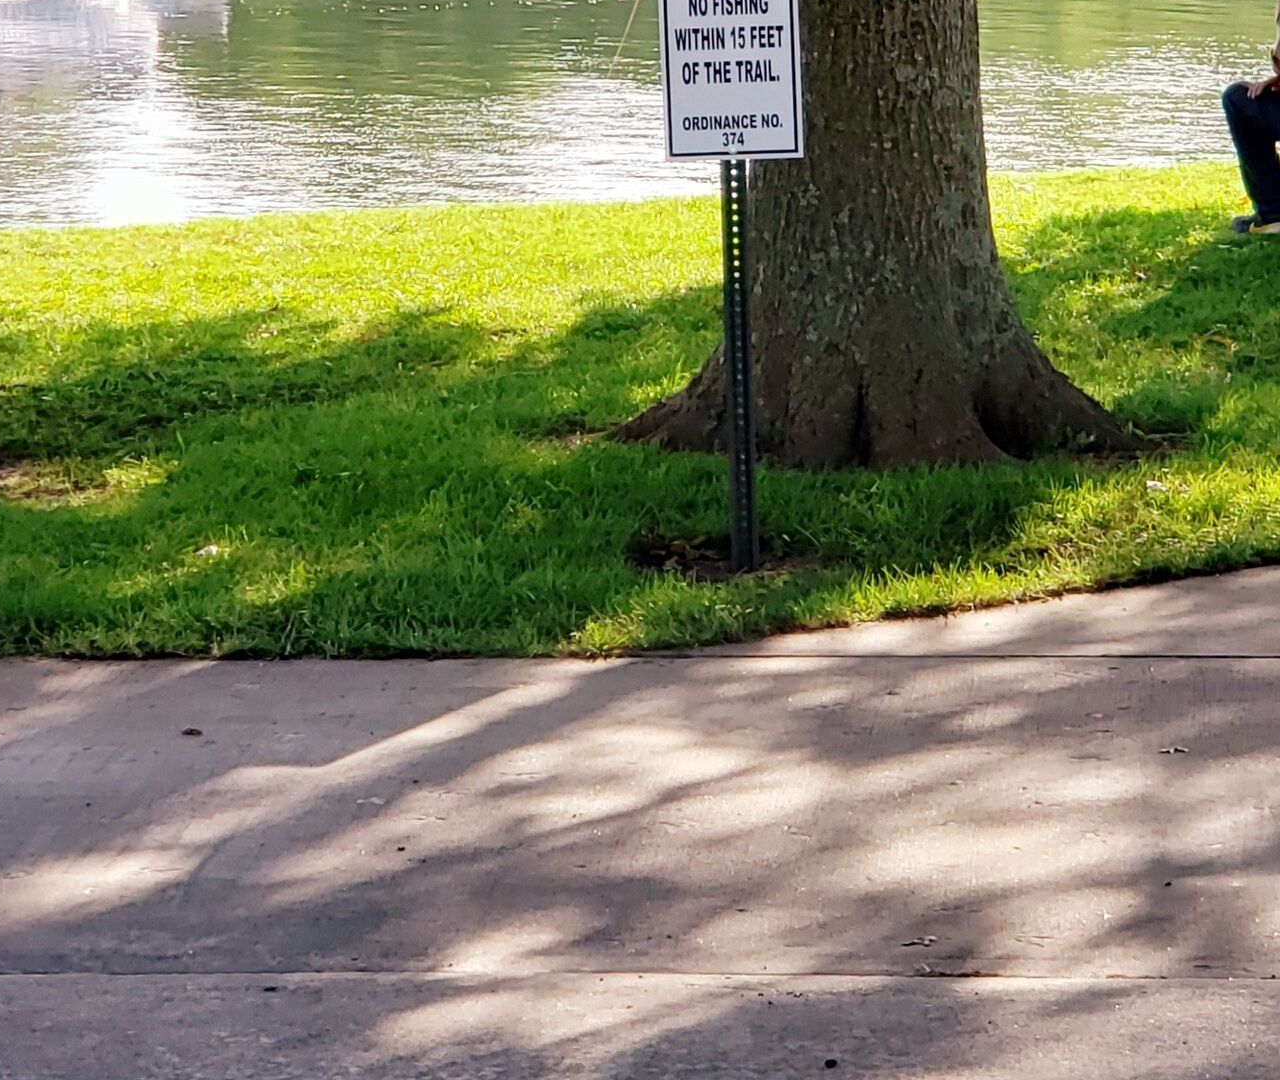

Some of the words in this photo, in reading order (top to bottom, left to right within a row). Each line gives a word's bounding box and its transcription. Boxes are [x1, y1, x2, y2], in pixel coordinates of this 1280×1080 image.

[674, 27, 725, 51] WITHIN
[730, 26, 746, 49] 15
[750, 25, 784, 48] FEET
[682, 62, 699, 85] OF
[704, 61, 731, 84] THE
[735, 59, 780, 83] TRAIL.
[682, 115, 757, 131] ORDINANCE
[761, 114, 783, 128] NO.
[722, 132, 745, 147] 374
